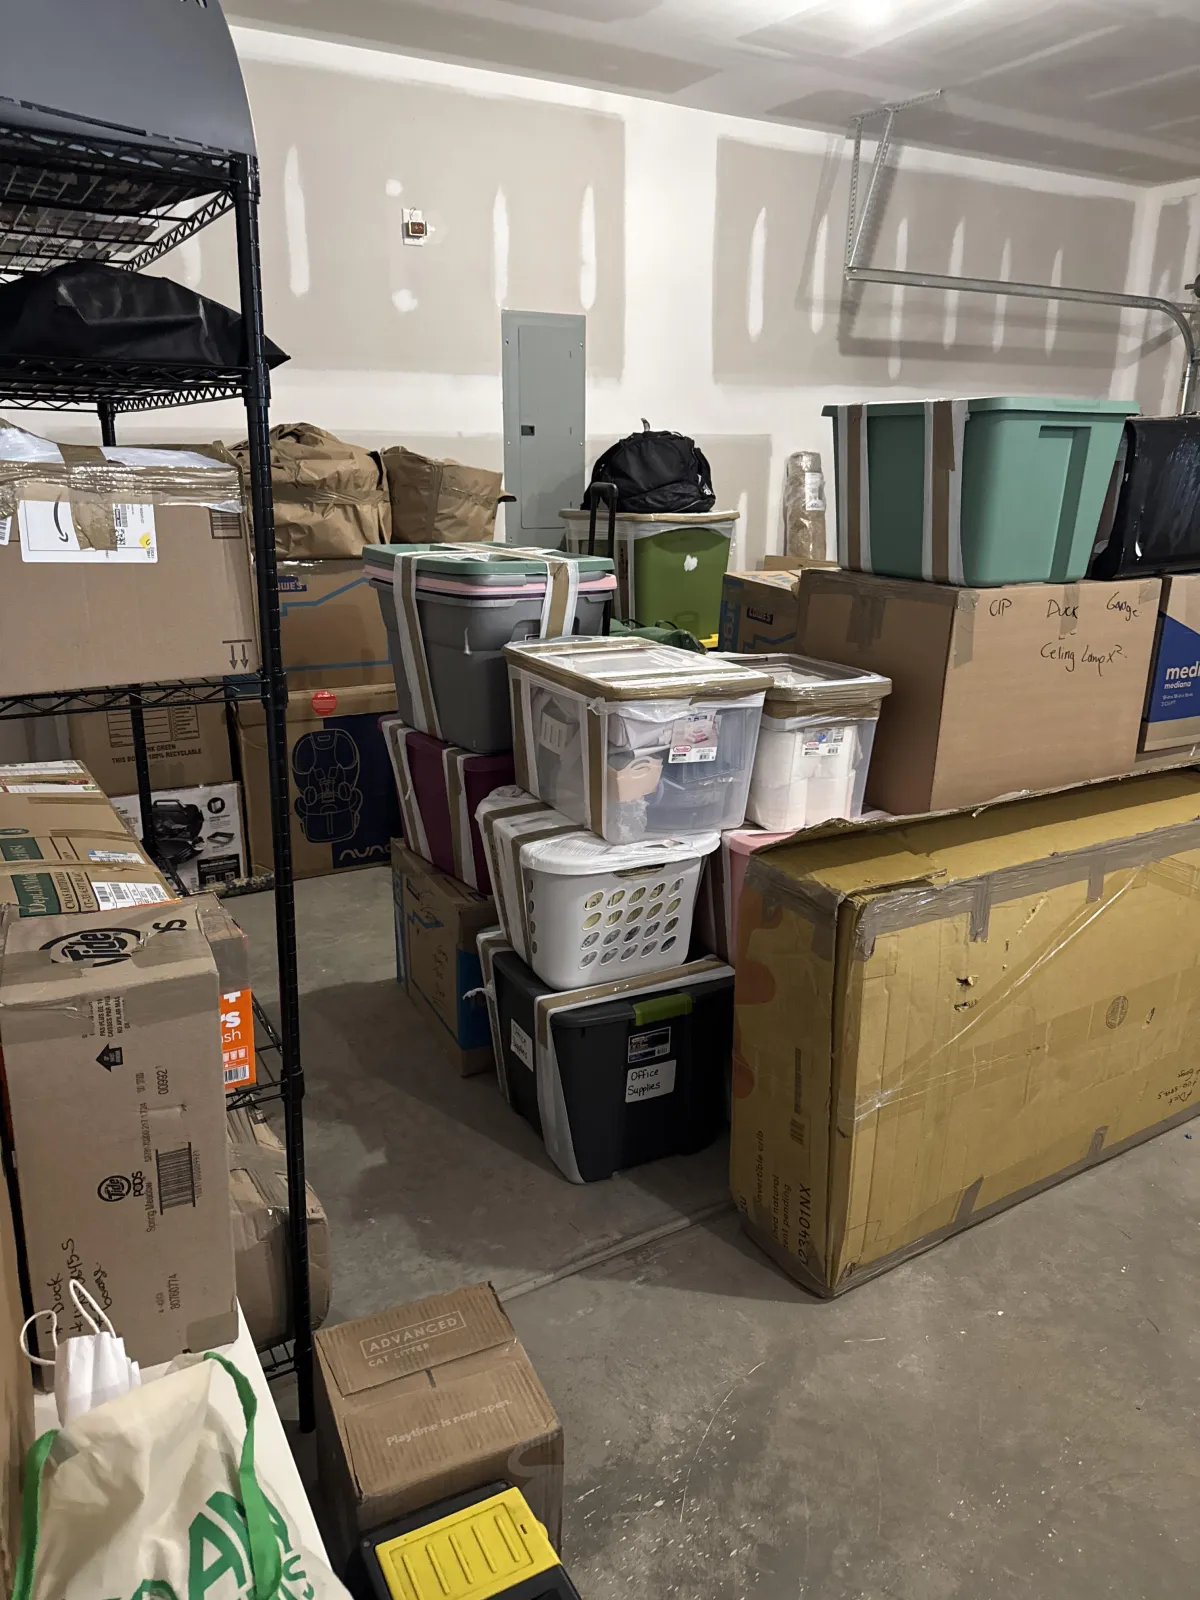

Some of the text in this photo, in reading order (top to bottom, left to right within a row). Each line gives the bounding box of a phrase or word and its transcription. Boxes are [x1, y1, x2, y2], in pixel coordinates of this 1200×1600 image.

[277, 580, 303, 591] WE'S
[148, 752, 165, 760] 100%
[165, 748, 202, 758] RECYCLABLE
[156, 744, 176, 752] GREEN
[223, 1029, 242, 1044] sh
[631, 1068, 659, 1081] Office
[628, 1081, 661, 1097] Supplies
[755, 1130, 764, 1206] nvertible crib
[105, 1178, 126, 1199] Tide
[131, 1170, 144, 1197] PODS
[771, 1174, 779, 1215] natural
[782, 1184, 791, 1228] pending
[369, 1317, 457, 1352] ADVANCED
[368, 1343, 430, 1367] CAT LITTER
[386, 1423, 439, 1447] Playtime
[441, 1418, 451, 1428] is
[452, 1410, 478, 1425] now
